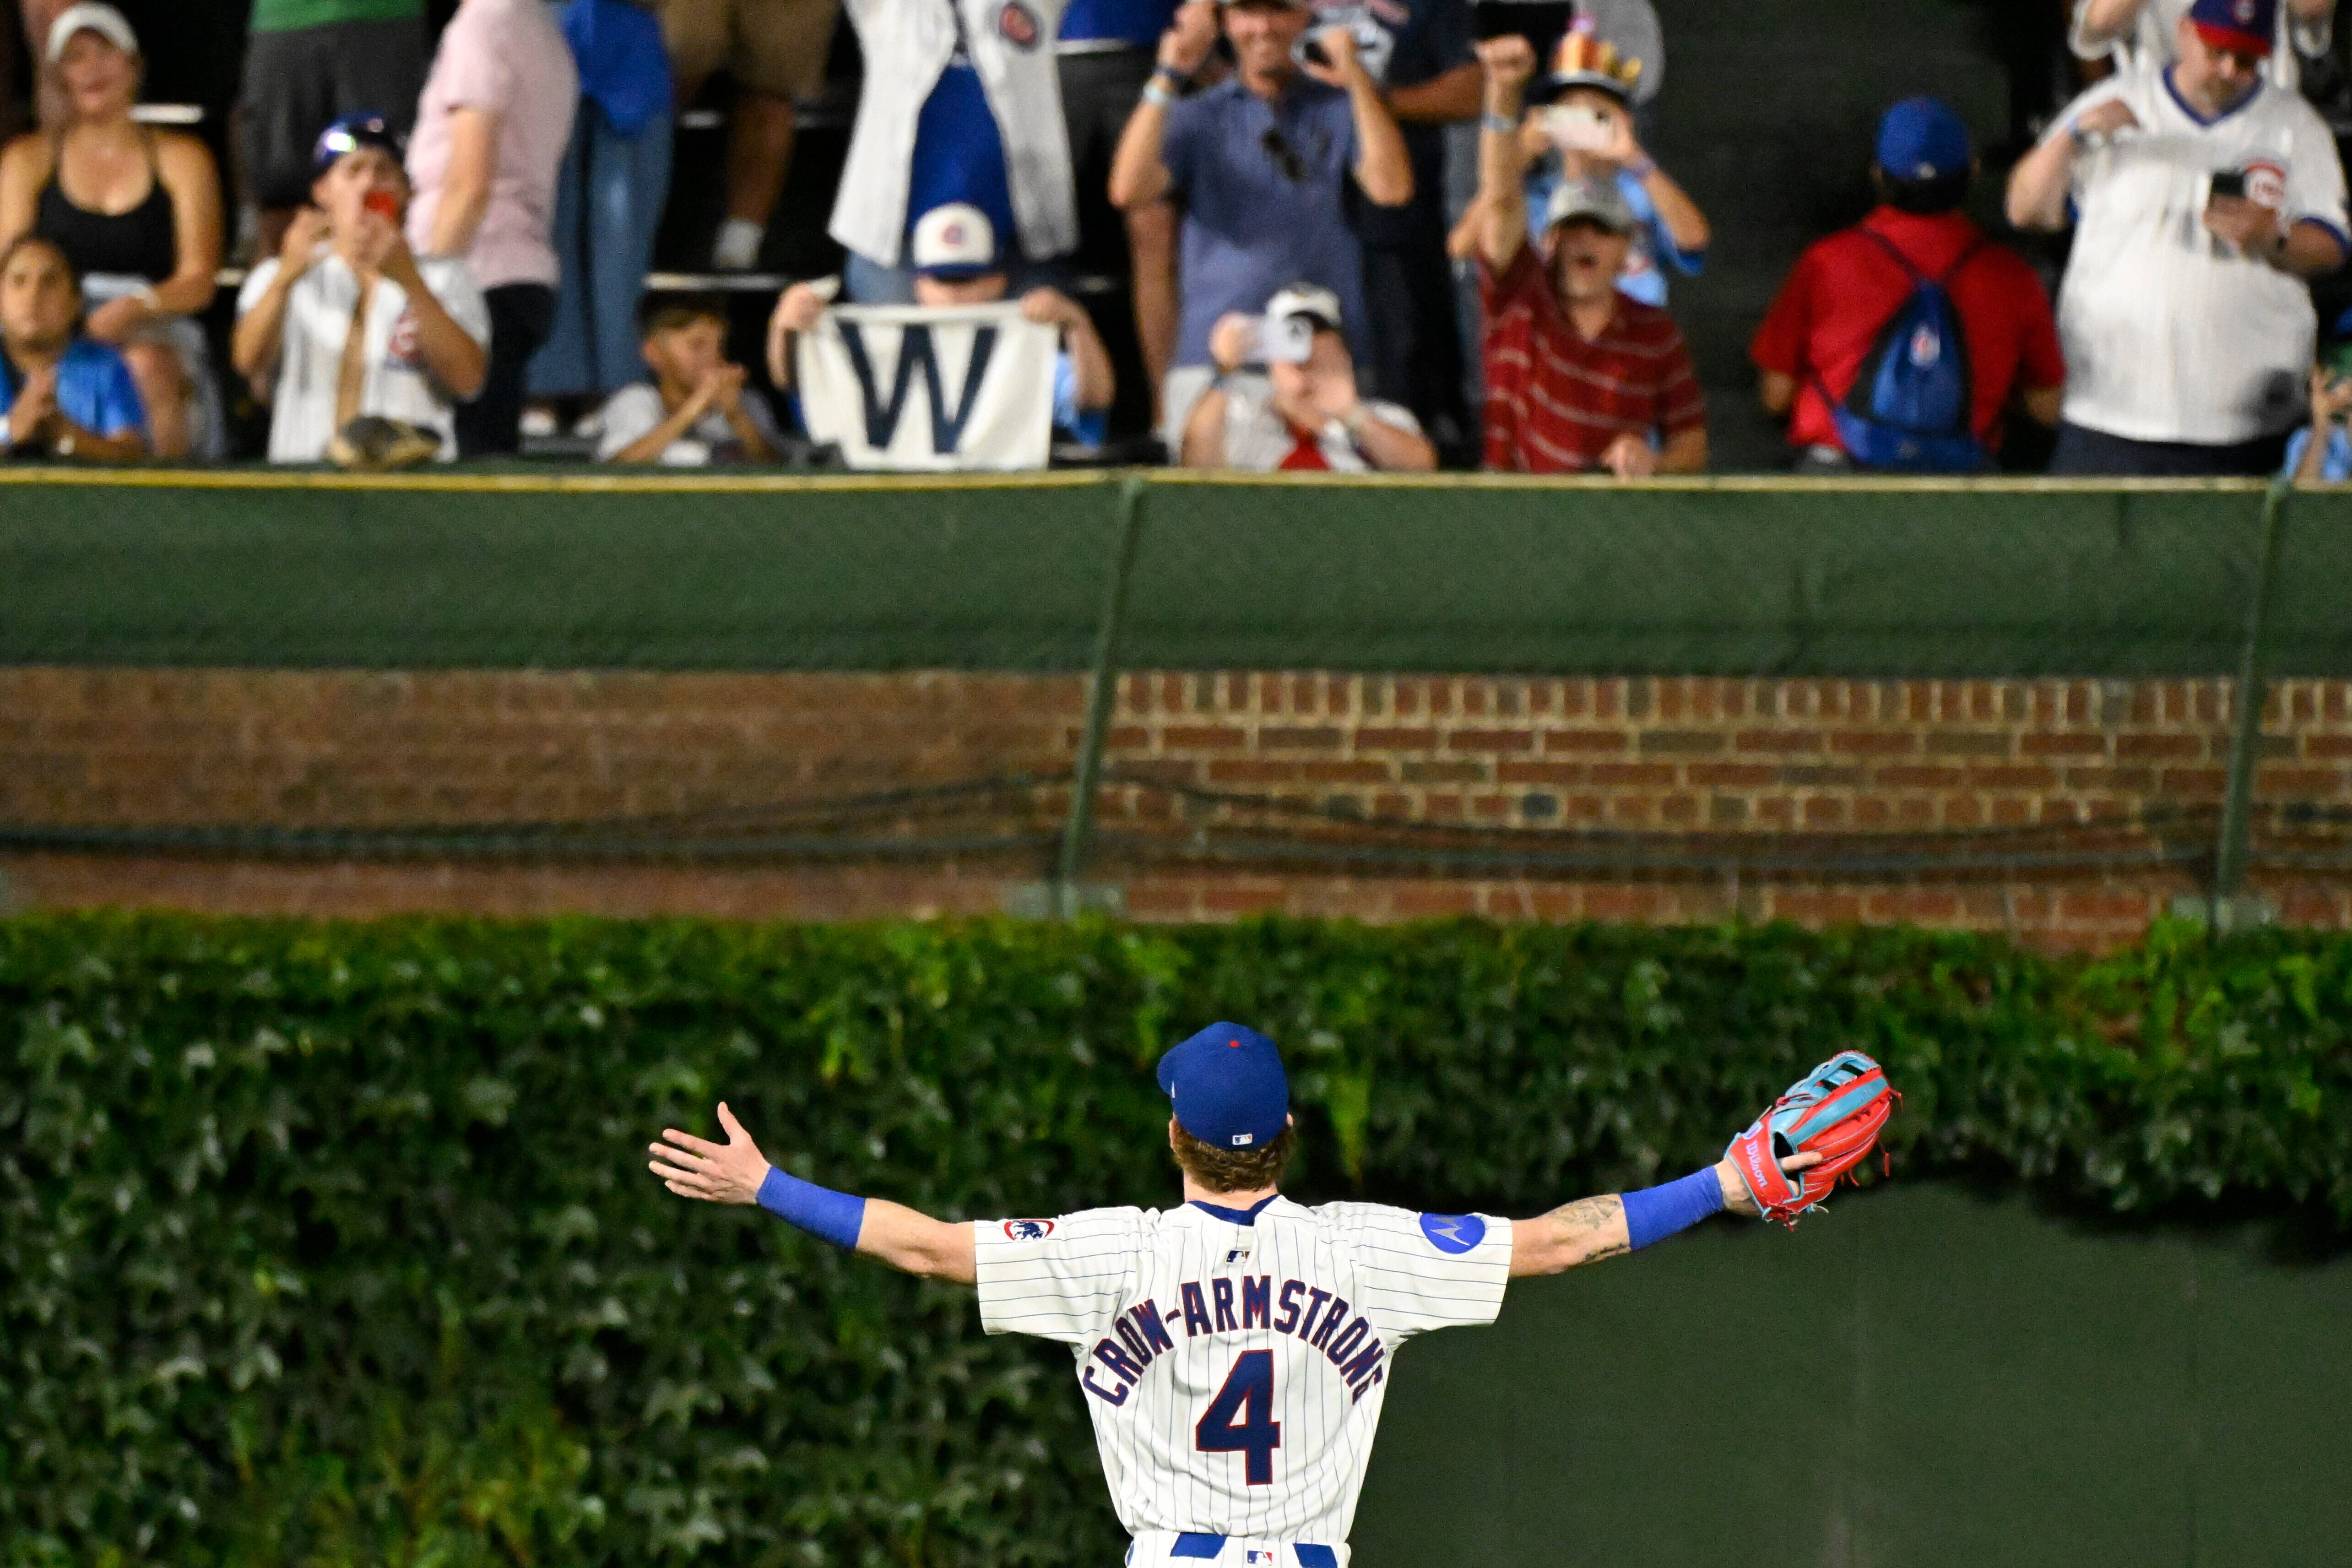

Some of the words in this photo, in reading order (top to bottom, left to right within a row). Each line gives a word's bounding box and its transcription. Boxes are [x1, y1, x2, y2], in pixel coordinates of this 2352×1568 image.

[835, 318, 999, 453] W
[1746, 1140, 1767, 1187] Wilson
[1195, 1349, 1281, 1486] 4
